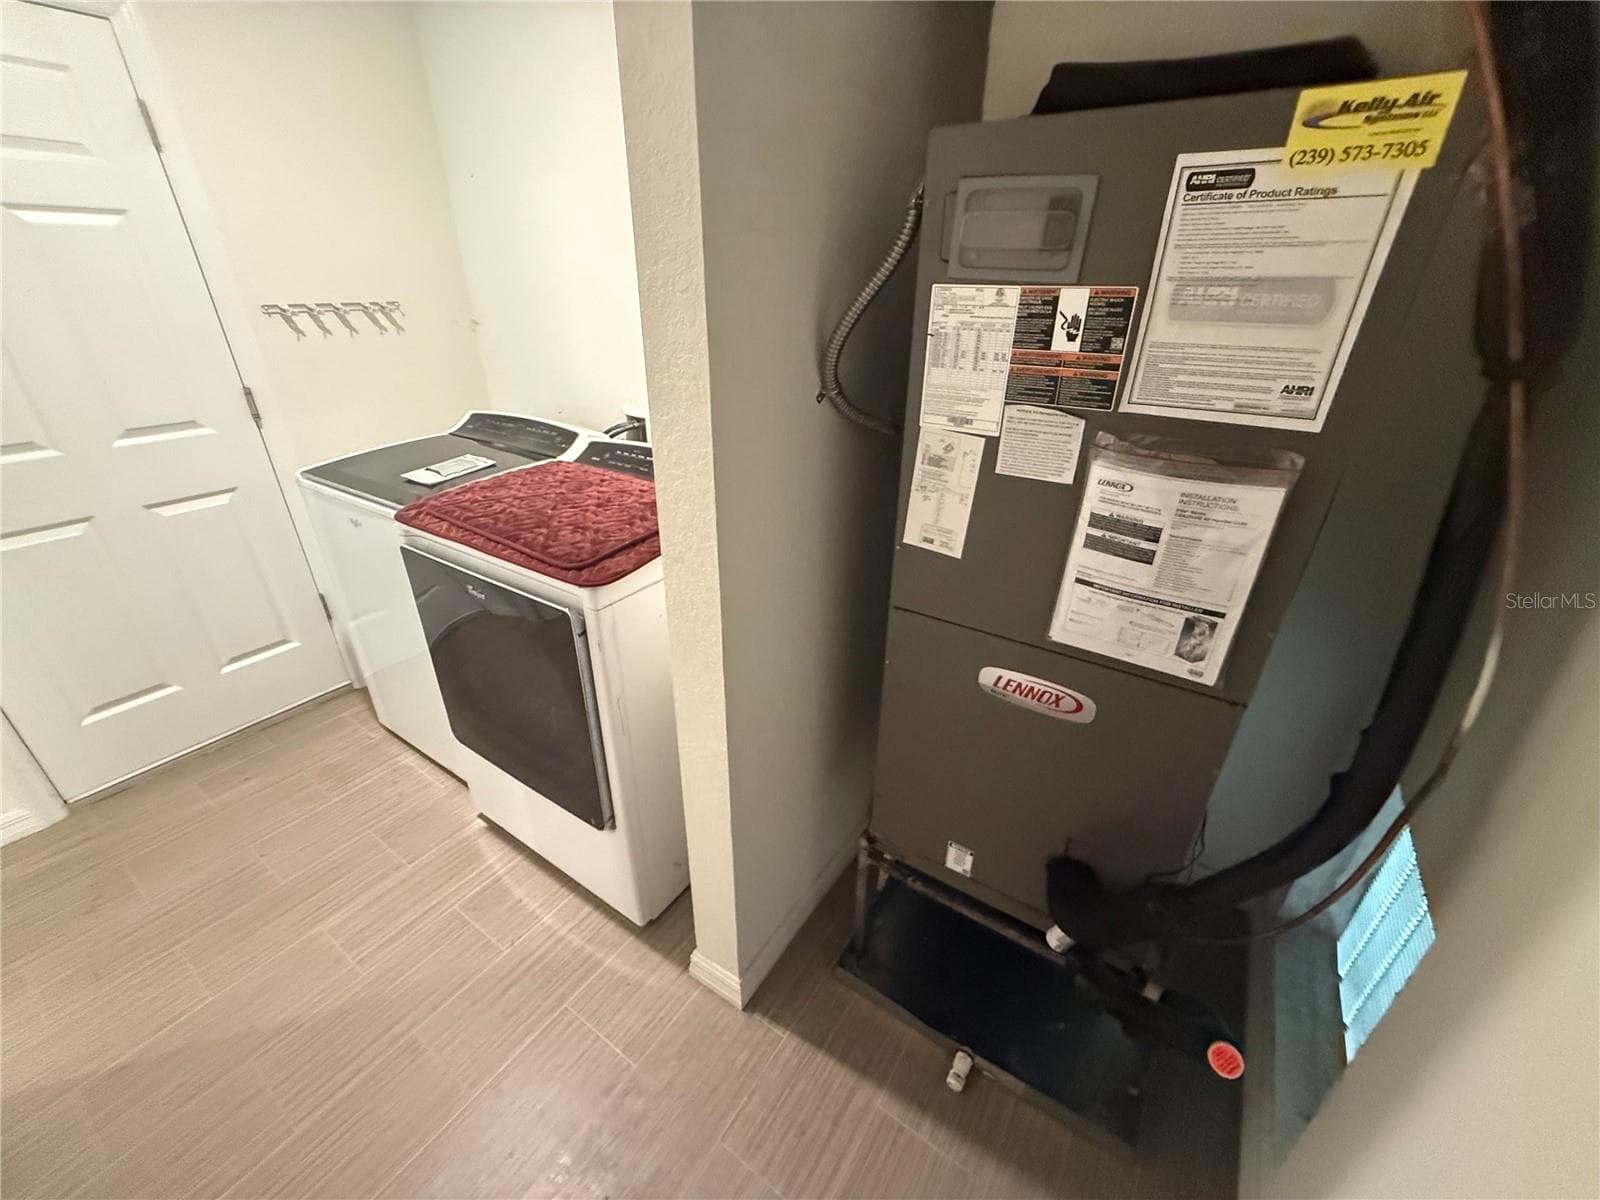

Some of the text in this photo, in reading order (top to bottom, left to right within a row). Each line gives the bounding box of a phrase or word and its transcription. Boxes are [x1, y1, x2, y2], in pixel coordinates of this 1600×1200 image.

[1337, 89, 1442, 114] Kelly Air
[1289, 139, 1429, 168] (239) 573-7305
[1183, 186, 1338, 202] Certificate of Product Ratings
[1280, 384, 1315, 396] AHRI
[1097, 478, 1126, 492] LENNOX
[1178, 499, 1240, 512] INSTRUCTIONS
[1180, 492, 1237, 504] INSTALLATION
[992, 675, 1066, 709] LENNOX
